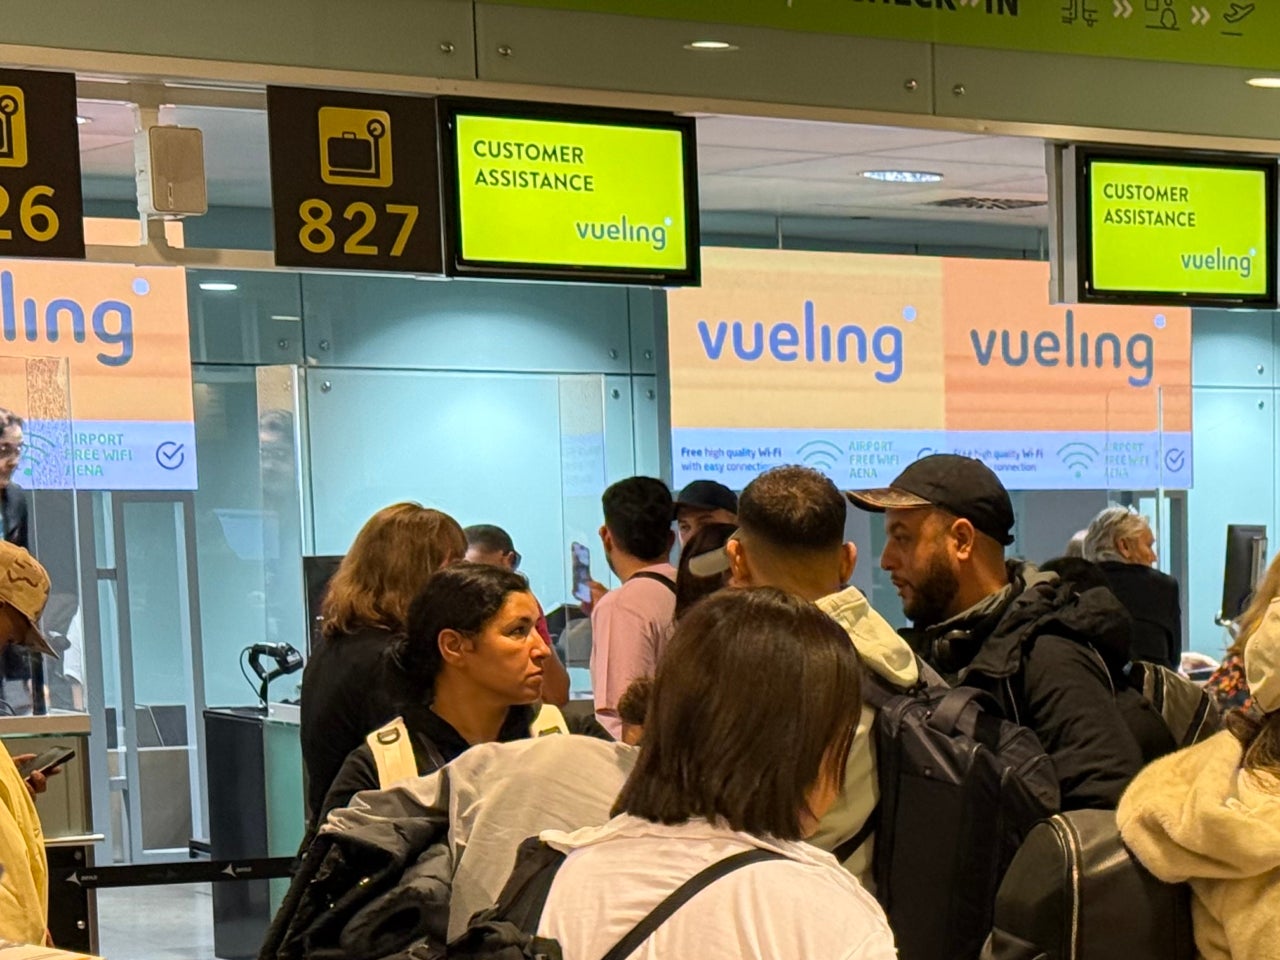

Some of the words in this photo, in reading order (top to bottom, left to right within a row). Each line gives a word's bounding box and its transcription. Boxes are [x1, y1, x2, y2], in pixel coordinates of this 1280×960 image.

[473, 140, 585, 165] CUSTOMER
[474, 167, 594, 192] ASSISTANCE
[1103, 183, 1189, 204] CUSTOMER
[298, 198, 419, 257] 827
[1103, 207, 1196, 229] ASSISTANCE
[575, 215, 667, 251] vueling
[1180, 248, 1252, 279] vueling
[697, 301, 905, 384] vueling
[970, 309, 1155, 388] vueling
[103, 449, 132, 461] WIFI
[682, 447, 703, 457] Free
[705, 447, 725, 459] high
[849, 440, 893, 451] AIRPORT
[849, 454, 877, 465] FREE
[877, 454, 900, 465] WIFI
[849, 467, 878, 478] AENA
